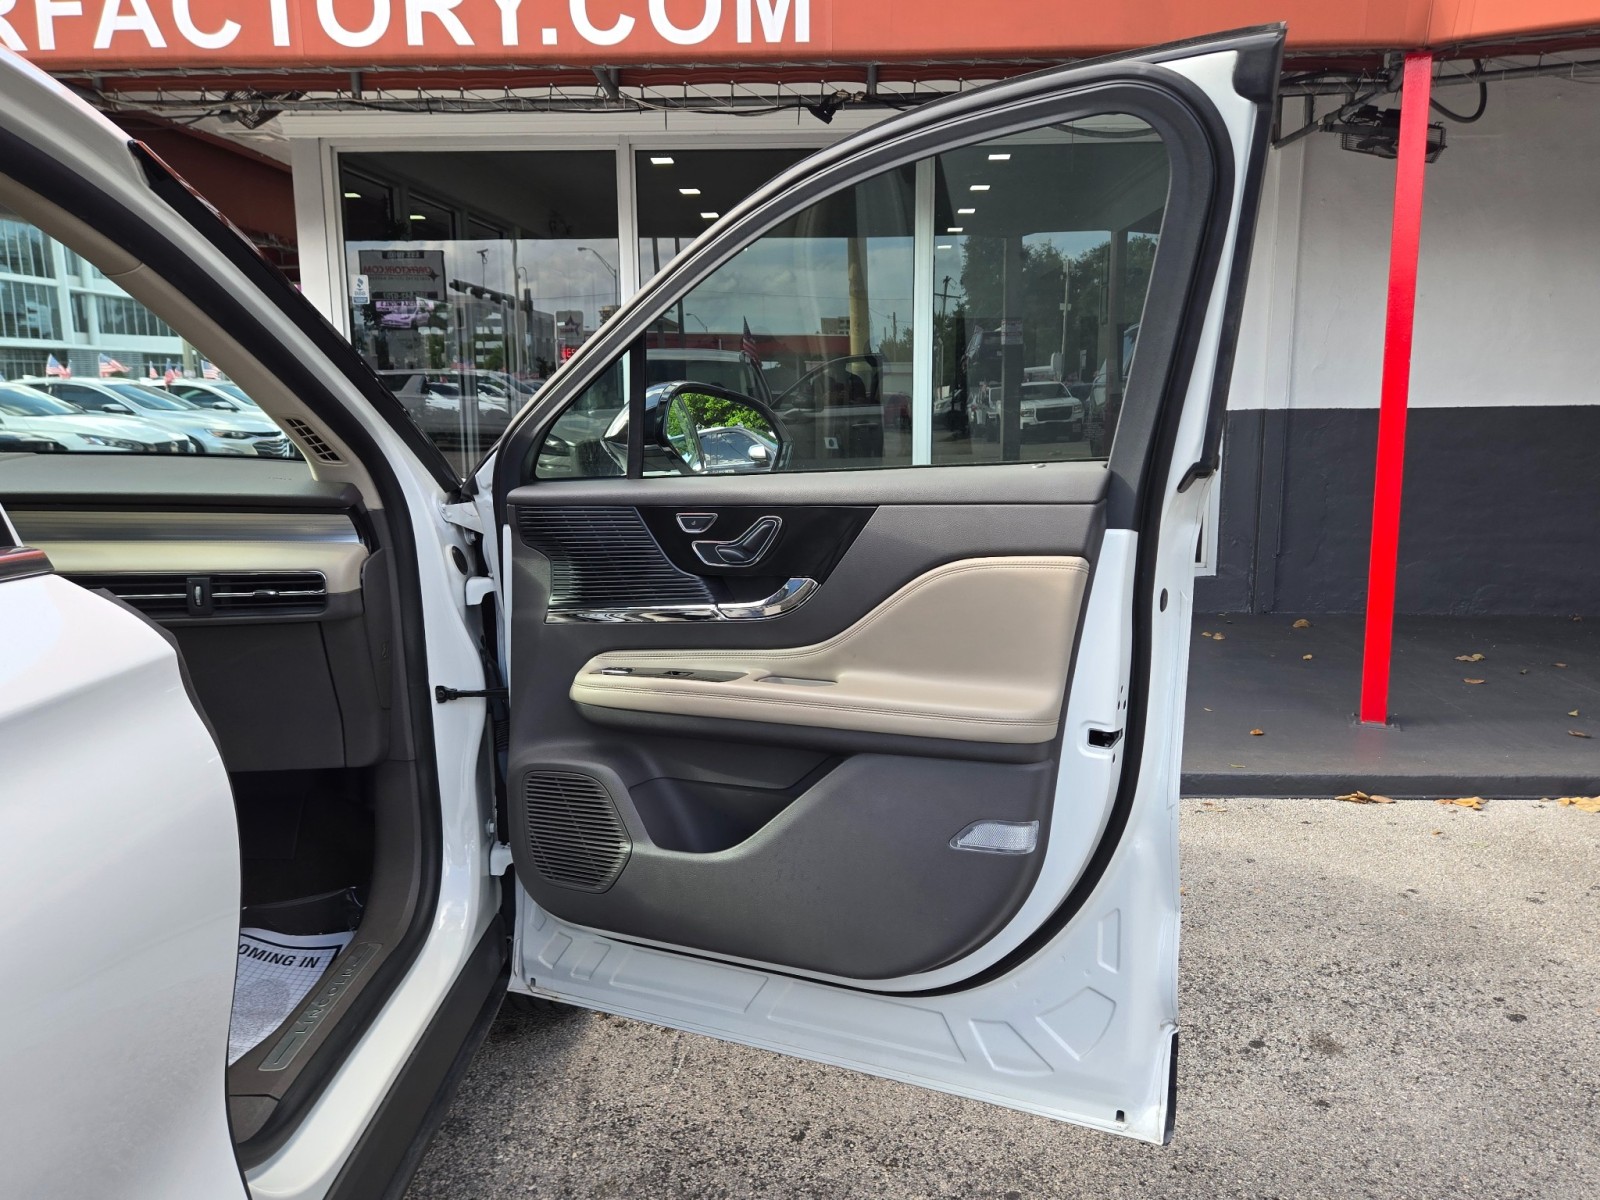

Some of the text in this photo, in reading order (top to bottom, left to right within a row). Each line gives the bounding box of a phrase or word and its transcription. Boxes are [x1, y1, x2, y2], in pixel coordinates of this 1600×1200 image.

[0, 0, 811, 51] FACTORY.COM
[298, 956, 321, 969] IN
[294, 963, 357, 1034] LINCOLN
